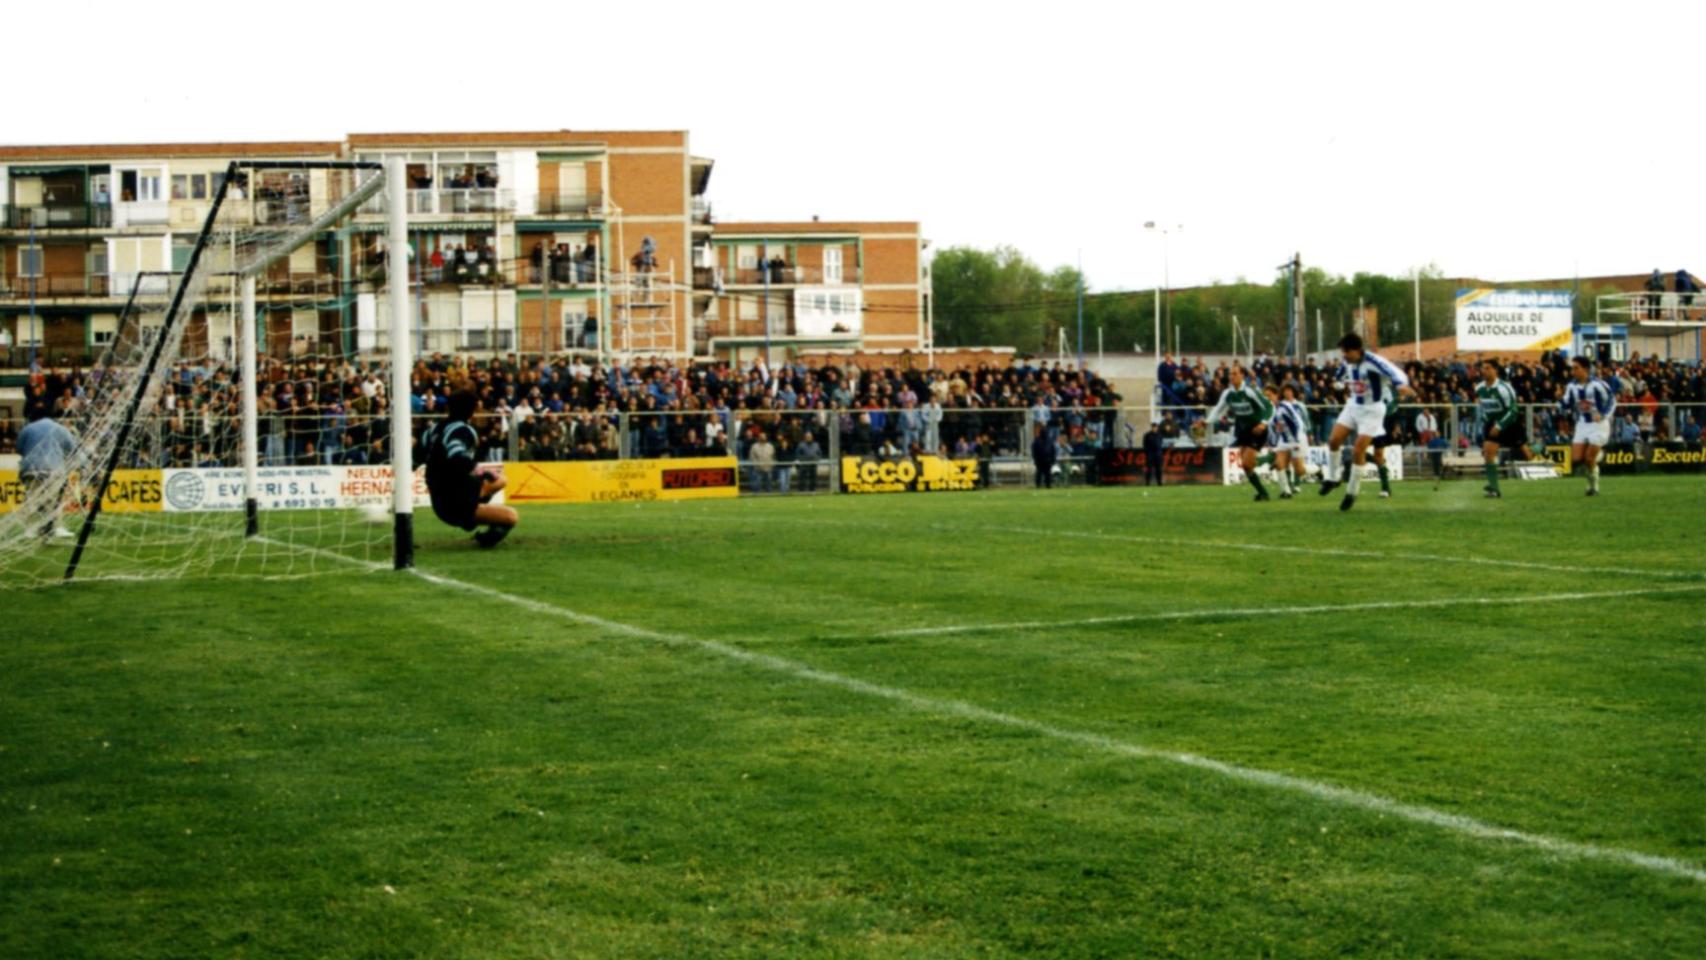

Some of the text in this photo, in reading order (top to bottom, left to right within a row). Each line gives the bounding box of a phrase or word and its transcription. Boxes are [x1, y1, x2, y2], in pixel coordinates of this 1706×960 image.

[1467, 312, 1544, 323] ALQUILER DE
[1468, 325, 1538, 336] AUTOCARES
[1112, 448, 1205, 468] Staford
